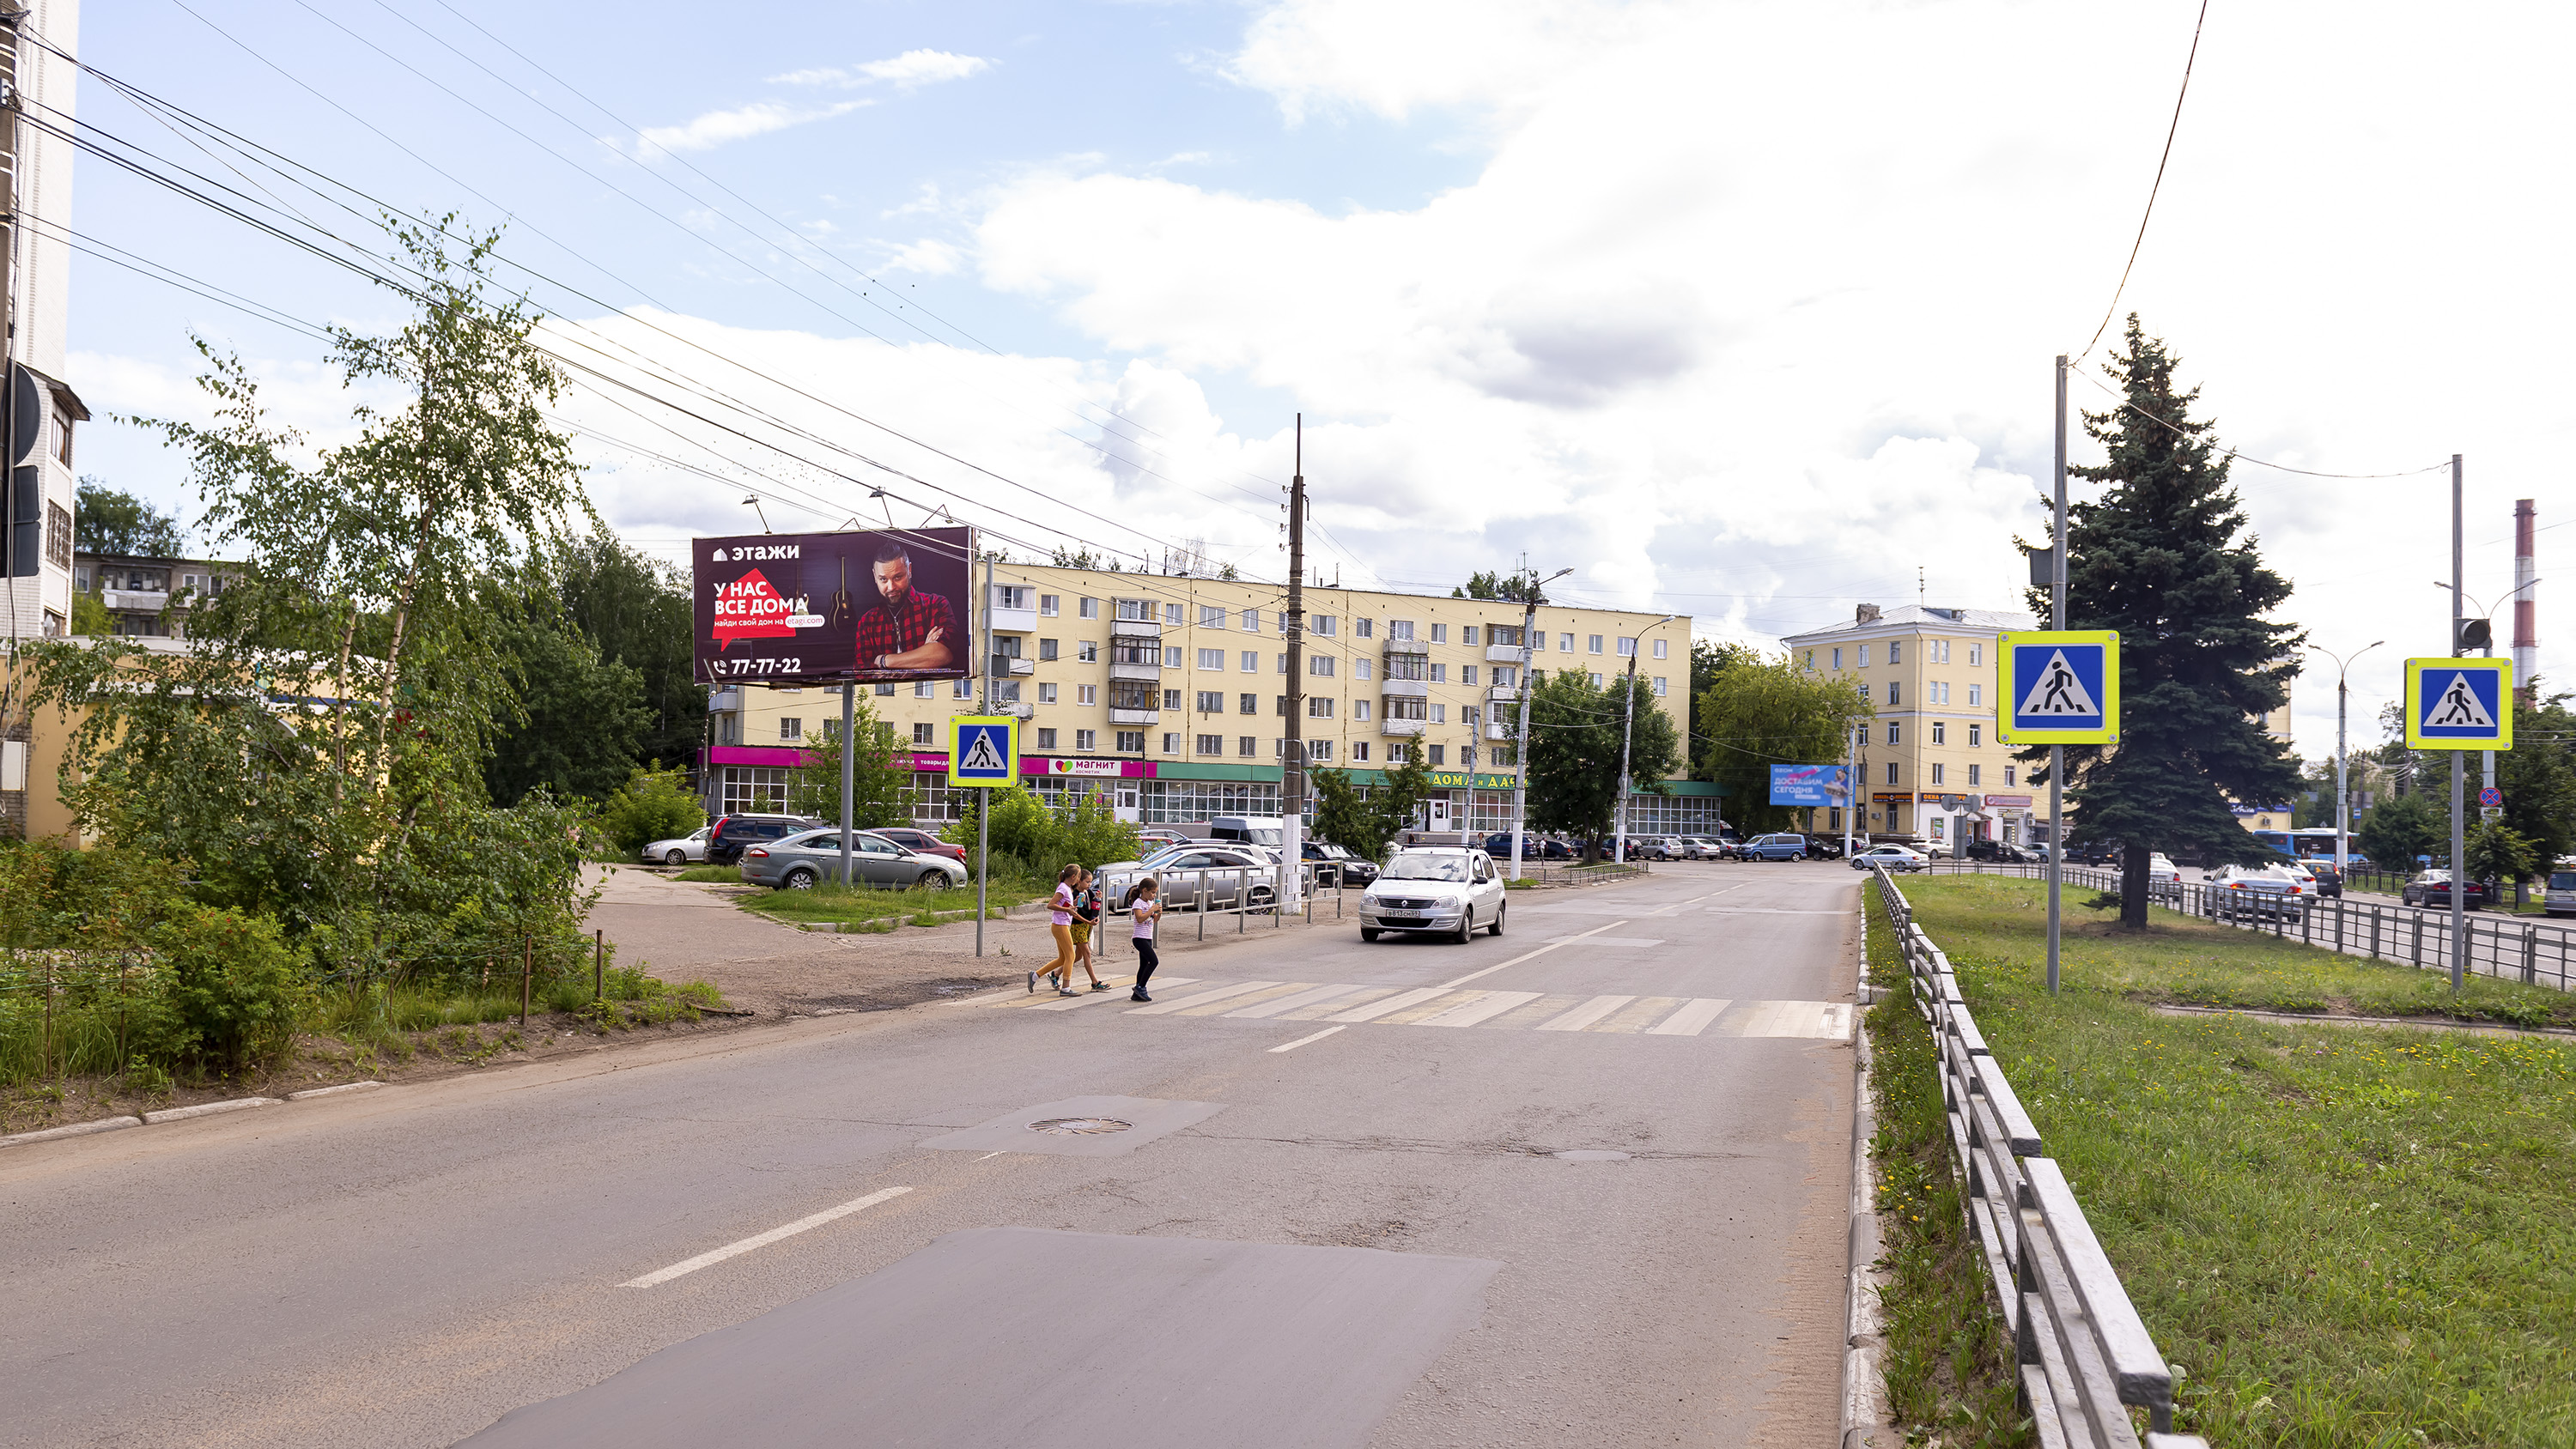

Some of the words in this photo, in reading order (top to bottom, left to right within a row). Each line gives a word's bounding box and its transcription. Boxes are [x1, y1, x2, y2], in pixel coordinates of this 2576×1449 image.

[714, 583, 726, 597] У
[730, 581, 768, 597] НАС
[714, 599, 746, 615] ВСЕ
[750, 597, 808, 615] ДОМА
[714, 619, 737, 627] найди
[738, 618, 756, 627] свой
[787, 616, 823, 627] etagi.com
[731, 658, 801, 675] 77-77-22
[1774, 786, 1813, 795] СЕГОДНЯ
